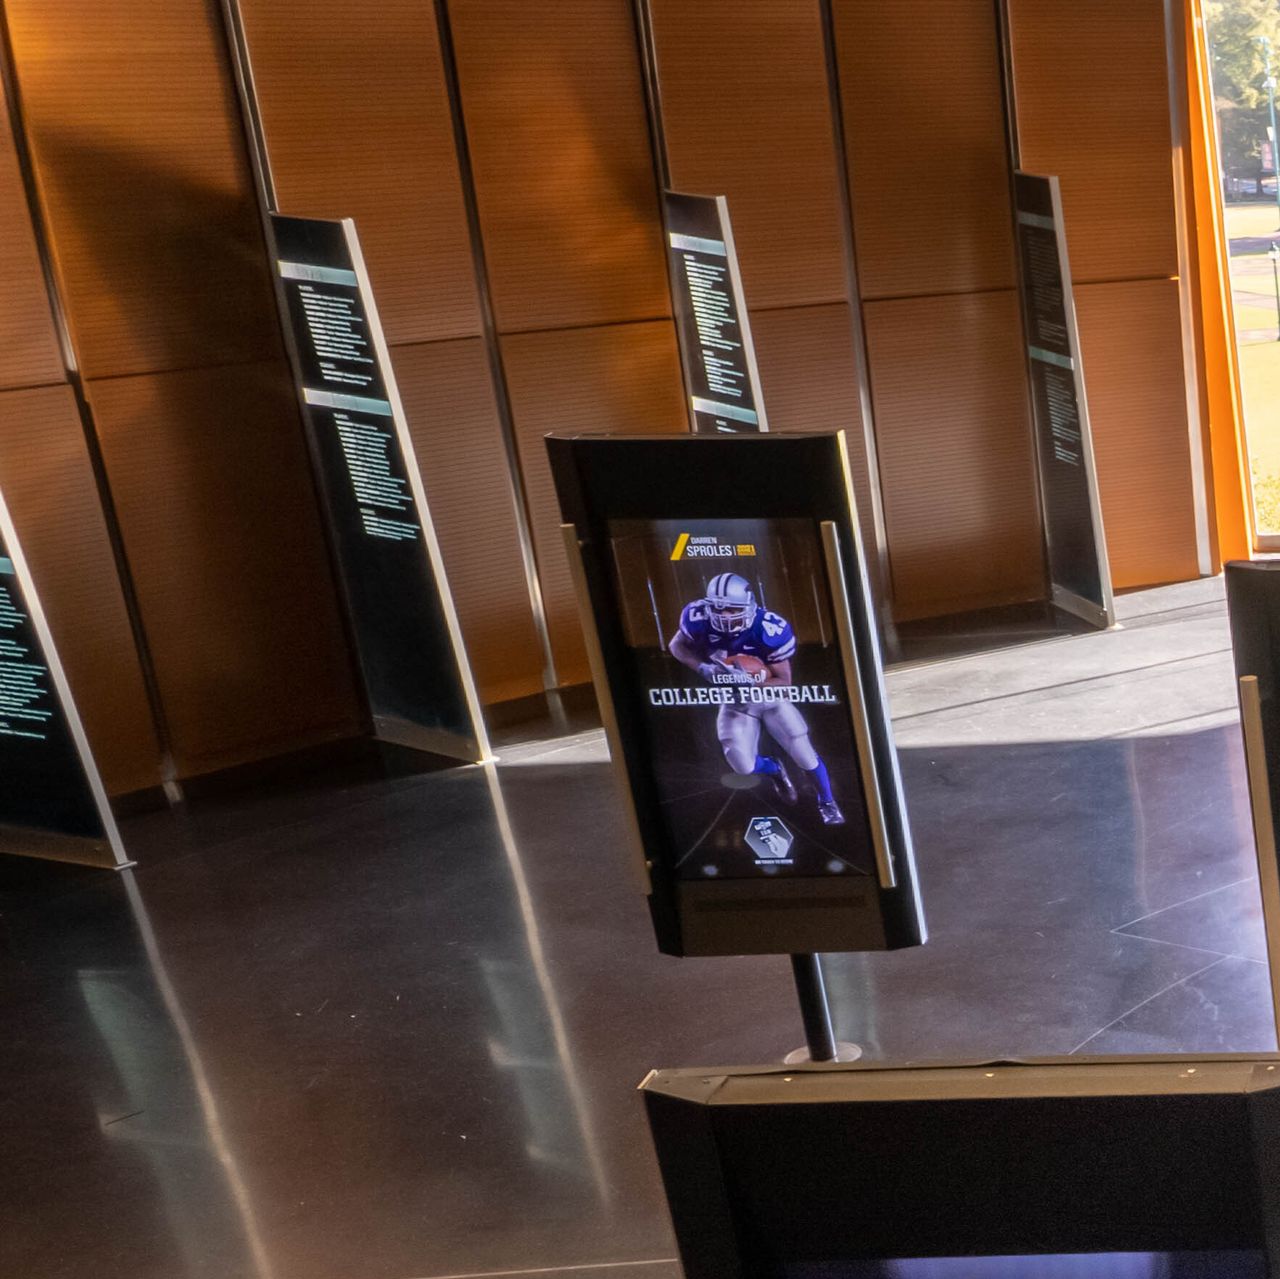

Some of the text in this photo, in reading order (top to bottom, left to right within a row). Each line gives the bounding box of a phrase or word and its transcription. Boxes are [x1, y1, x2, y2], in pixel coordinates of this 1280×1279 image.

[686, 545, 732, 556] SPROLES
[712, 674, 752, 684] LEGENDS
[650, 685, 836, 705] COLLEGE FOOTBALL
